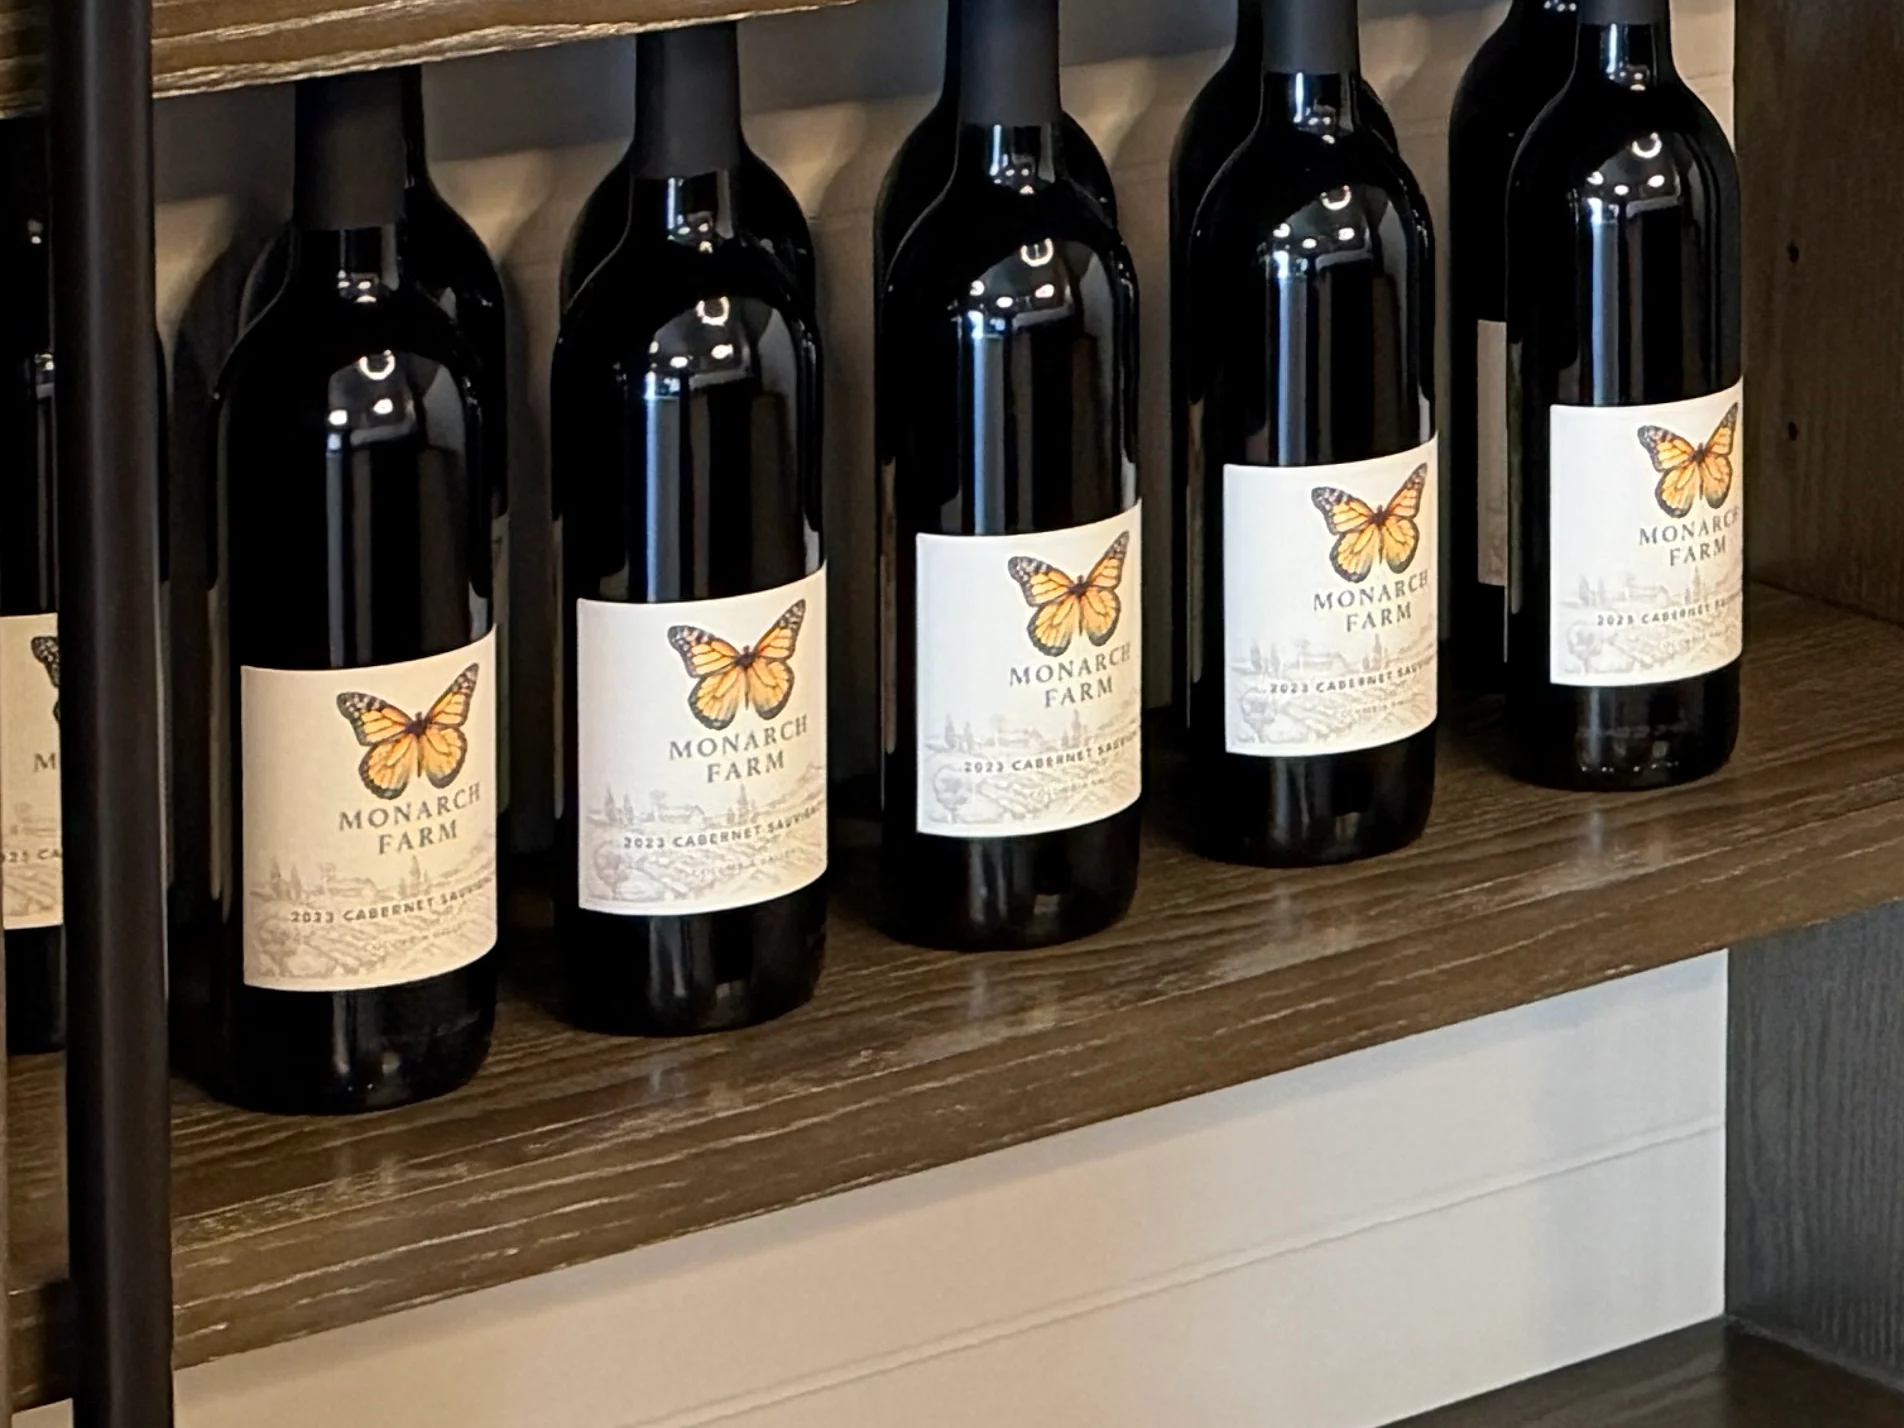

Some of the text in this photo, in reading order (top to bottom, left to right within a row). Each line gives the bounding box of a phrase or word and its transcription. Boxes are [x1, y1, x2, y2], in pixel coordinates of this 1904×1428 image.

[1669, 534, 1727, 567] FARM
[1313, 569, 1429, 613] MONARCH
[1345, 601, 1413, 633] FARM
[1640, 603, 1711, 625] CABERNET
[1009, 642, 1132, 687] MONARCH
[1044, 675, 1113, 709] FARM
[1315, 670, 1394, 694] CABERNET
[669, 713, 808, 761] MONARCH
[706, 749, 785, 784] FARM
[1011, 748, 1093, 772] CABERNET
[338, 782, 481, 832] MONARCH
[378, 819, 458, 855] FARM
[623, 836, 665, 849] 2023
[672, 824, 762, 848] CABERNET
[343, 896, 435, 922] CABERNET
